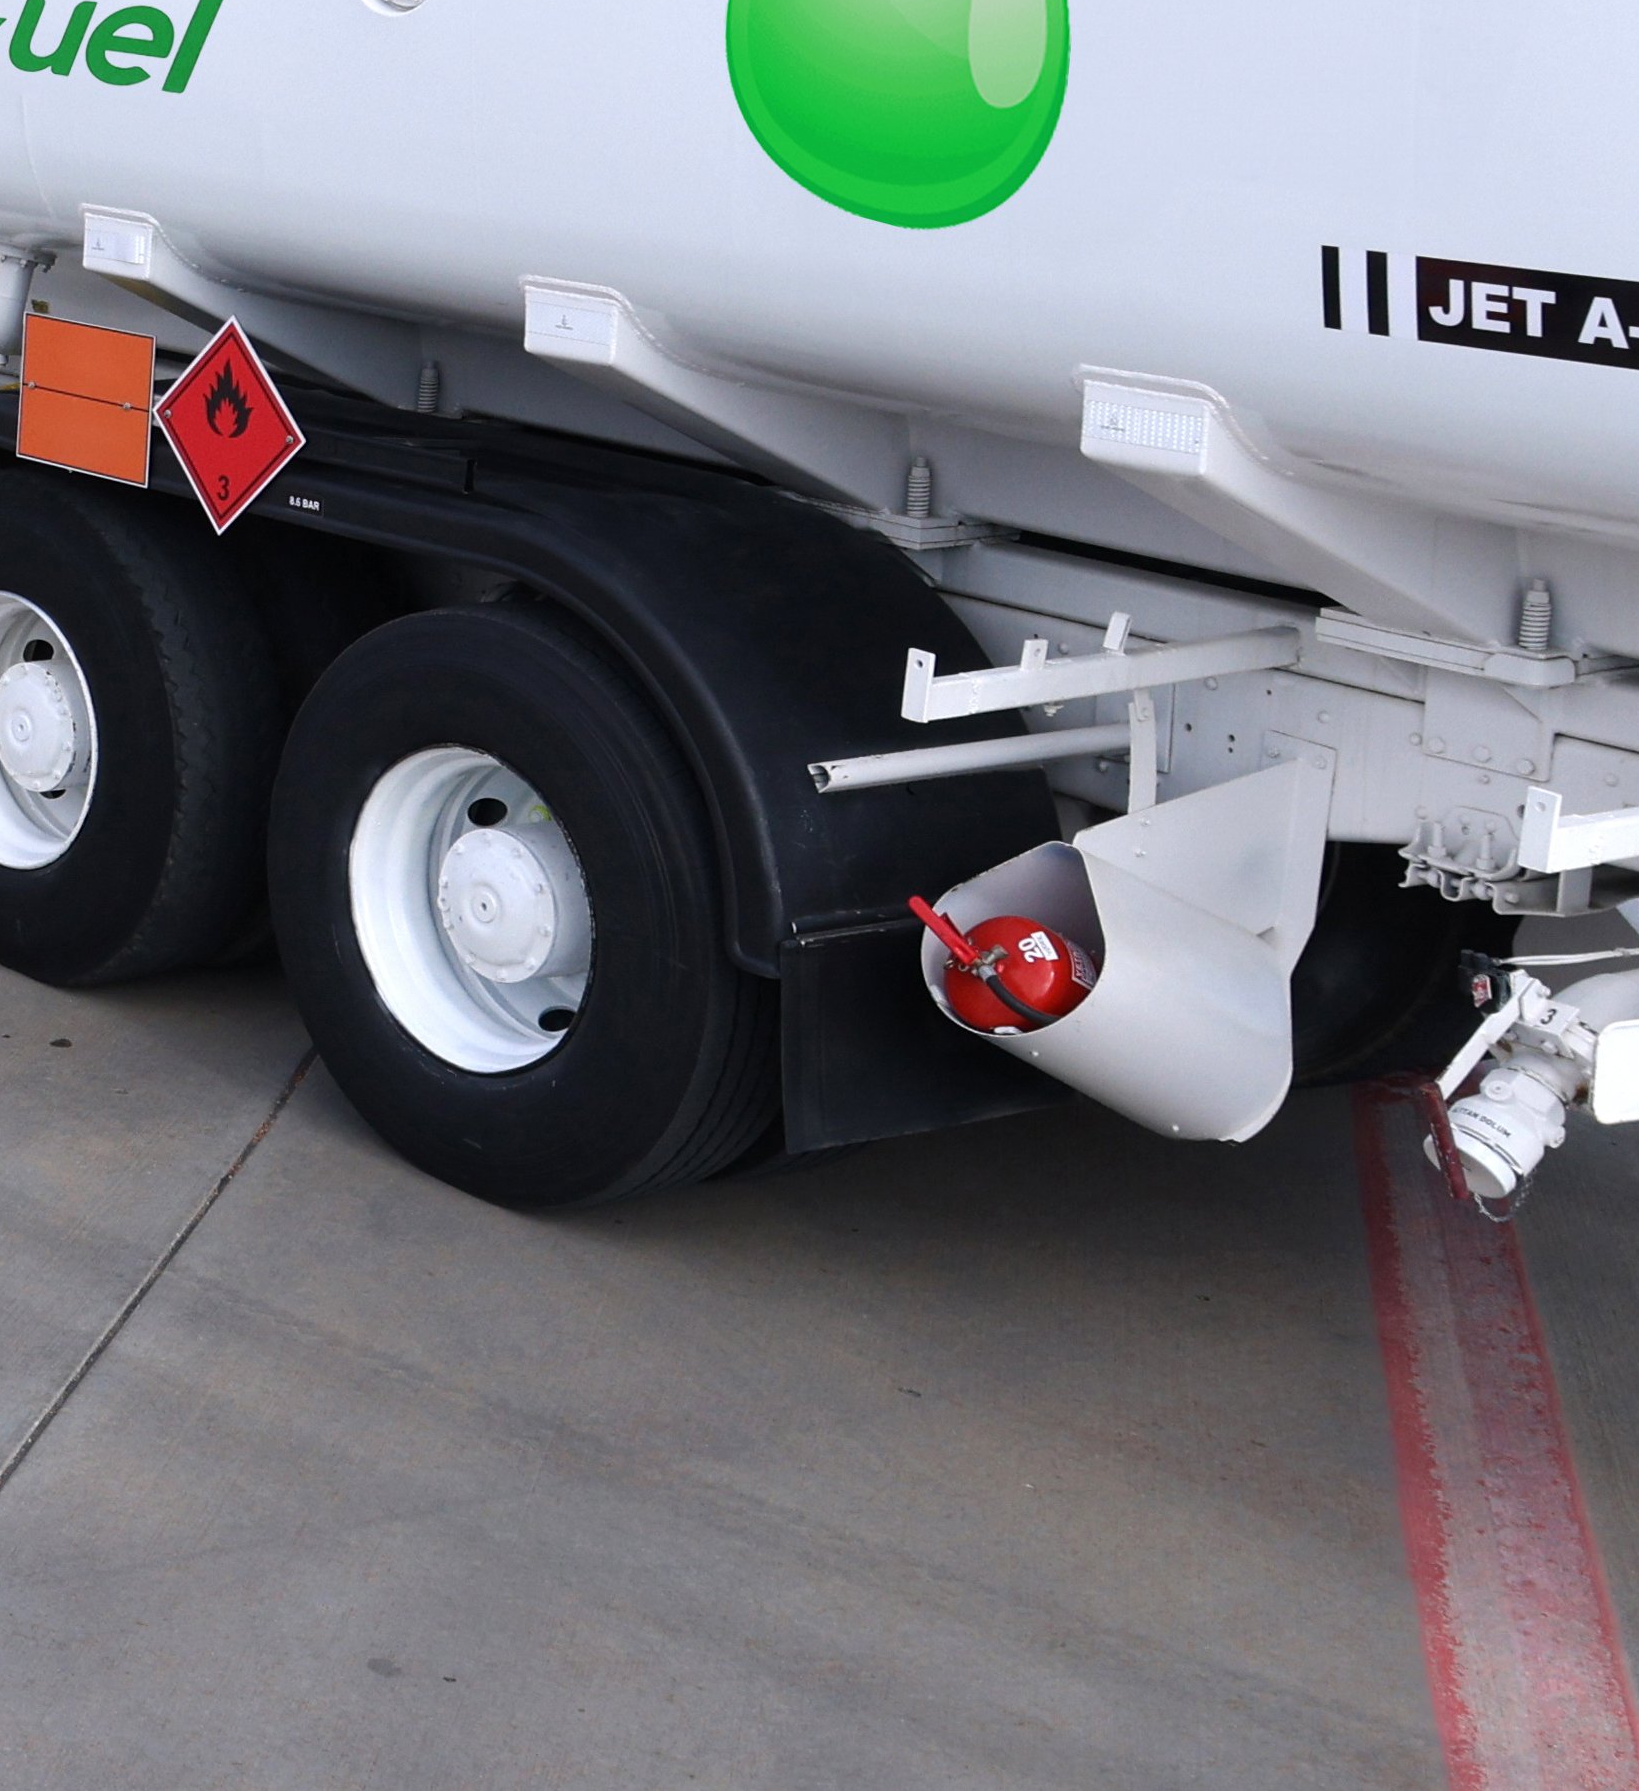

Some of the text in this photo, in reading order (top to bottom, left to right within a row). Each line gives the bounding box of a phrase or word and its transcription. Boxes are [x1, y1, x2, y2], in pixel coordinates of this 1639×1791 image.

[1428, 278, 1556, 338] JET
[216, 474, 230, 501] 3
[302, 498, 320, 511] BAR
[1018, 937, 1044, 963] 20
[1539, 1008, 1557, 1025] 3
[1479, 1115, 1512, 1139] DOLUM
